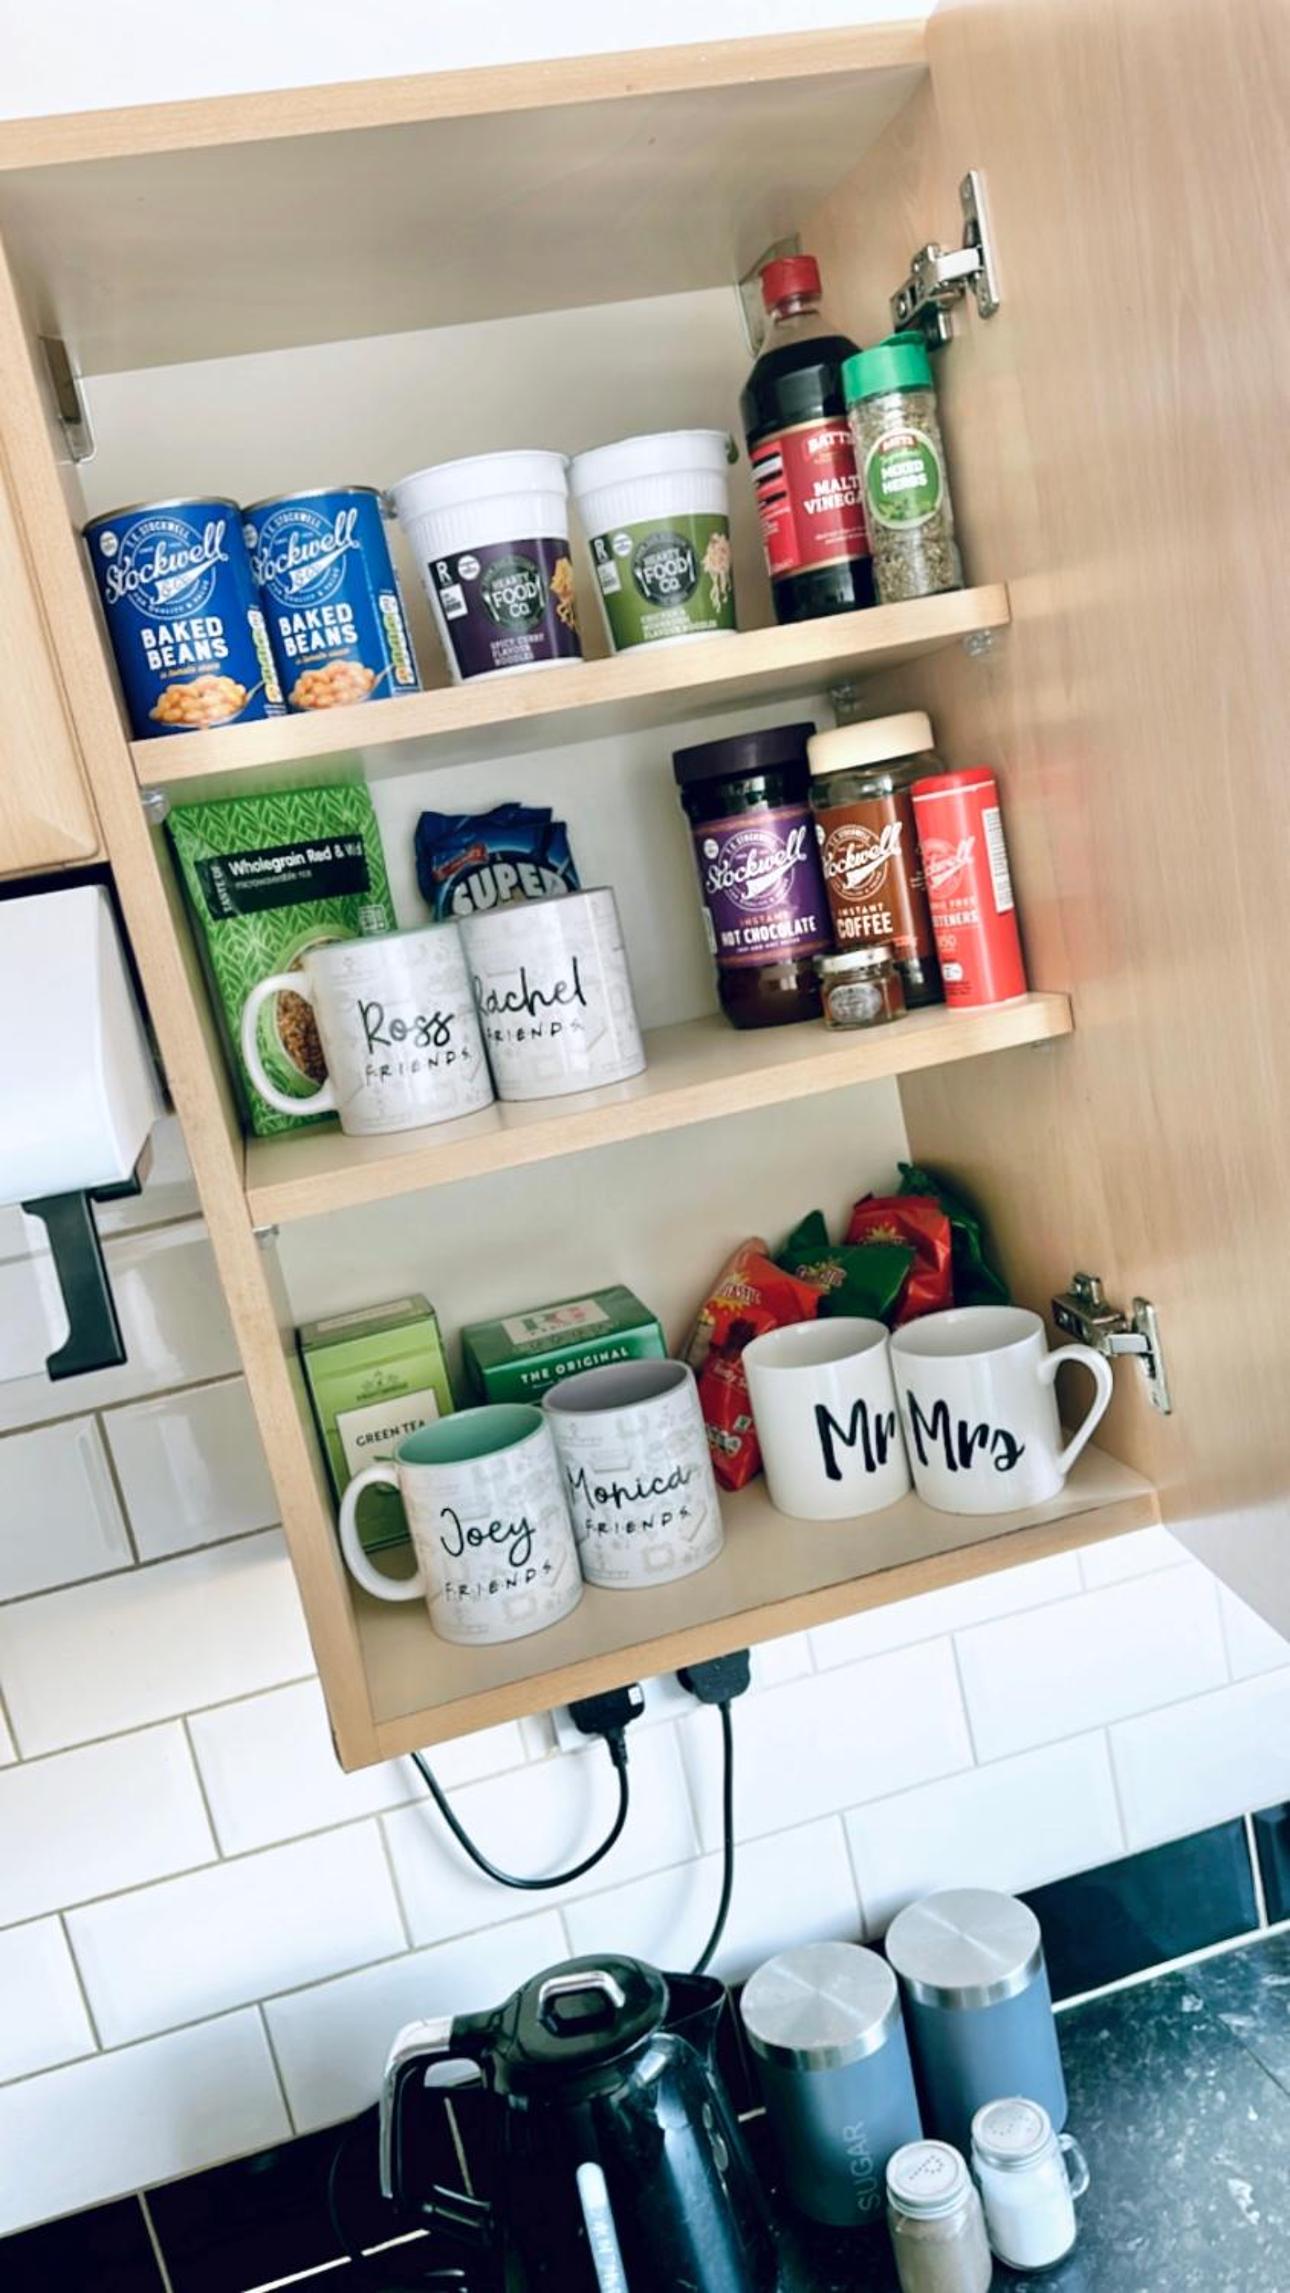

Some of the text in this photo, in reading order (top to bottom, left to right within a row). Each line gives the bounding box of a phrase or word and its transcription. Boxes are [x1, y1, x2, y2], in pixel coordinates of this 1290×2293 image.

[813, 475, 859, 497] MALT
[881, 460, 925, 480] MIXED
[881, 473, 929, 495] HERBS
[105, 519, 229, 604] Stockwell
[643, 557, 688, 584] FOOD
[492, 581, 537, 608] FOOD
[140, 616, 224, 650] BAKED
[278, 603, 353, 637] BAKED
[146, 637, 229, 671] BEANS
[283, 624, 358, 658] BEANS
[229, 851, 306, 877] Wholegrain
[306, 845, 333, 863] Red
[334, 844, 345, 858] &
[706, 825, 807, 894] Stockwell
[822, 821, 902, 880] tockwell
[451, 861, 568, 915] SUPER
[836, 911, 893, 940] COFFEE
[837, 902, 884, 917] INSTANT
[721, 929, 741, 948] HOT
[743, 915, 817, 944] CHOCOLATE
[357, 999, 455, 1054] Ross
[365, 1047, 471, 1086] FRIENDS
[520, 1370, 550, 1385] THE
[555, 1346, 630, 1375] ORIGINAL
[355, 1418, 427, 1448] GREEN TEA
[814, 1398, 896, 1481] Mr
[906, 1389, 1026, 1473] Mrs
[566, 1465, 693, 1511] Monica
[440, 1507, 536, 1568] Joey
[584, 1505, 692, 1536] FRIENDS
[445, 1560, 554, 1598] FRIENDS
[843, 2121, 882, 2211] SUGAR
